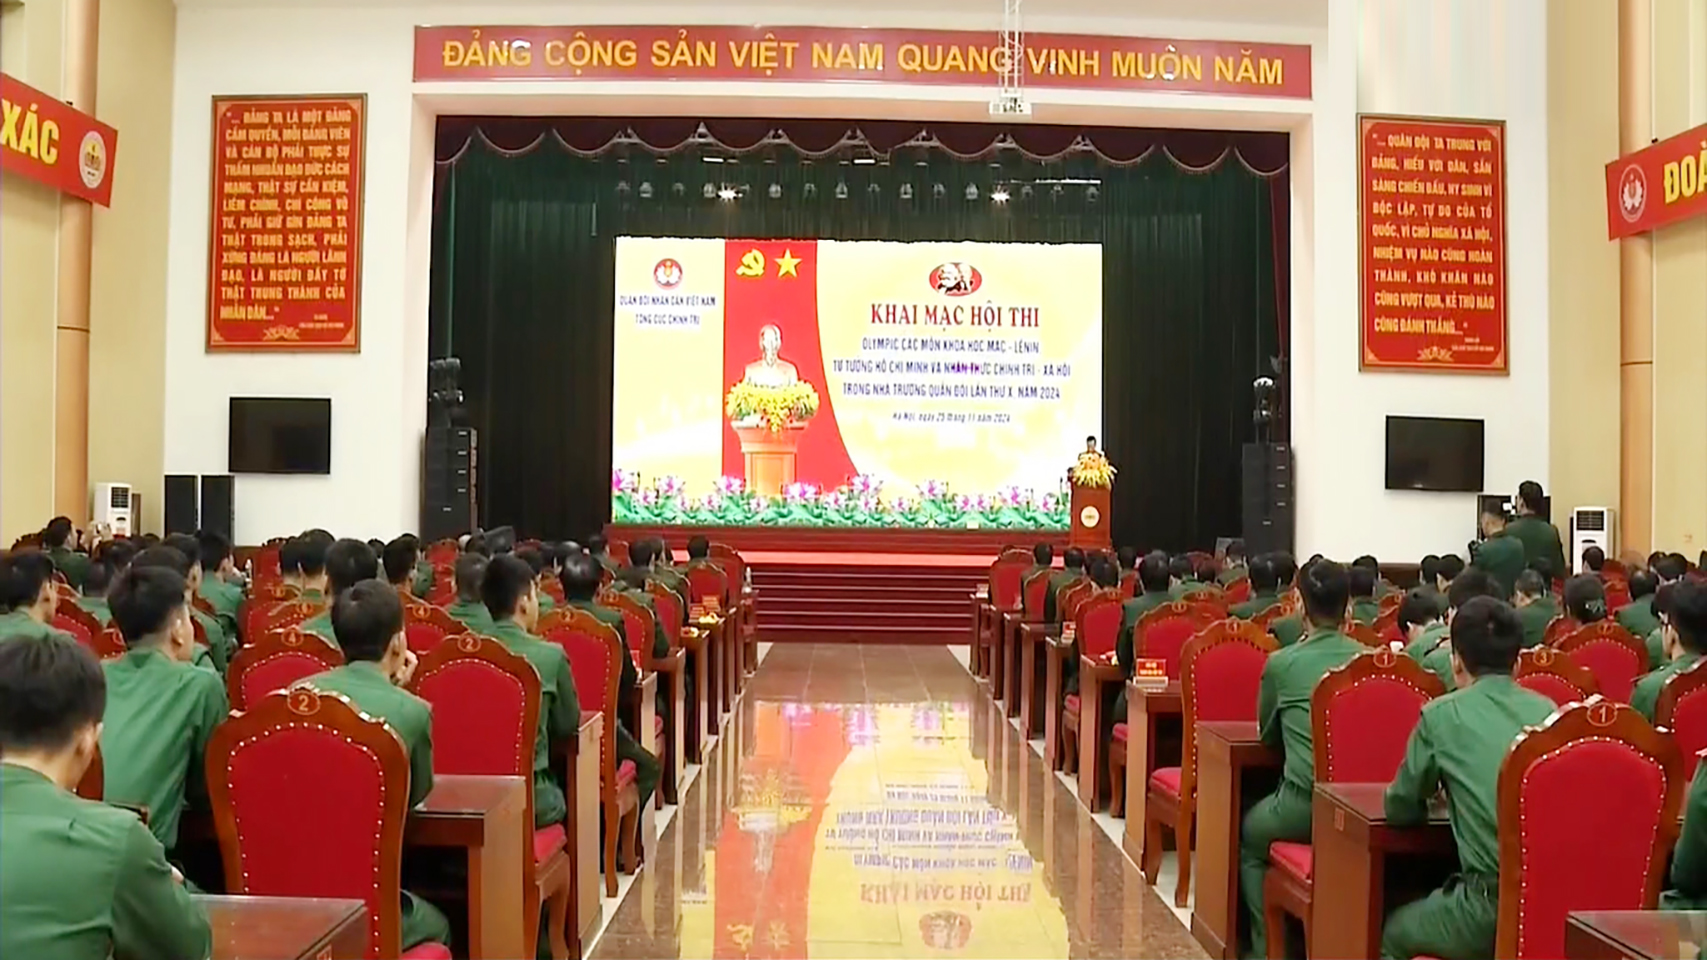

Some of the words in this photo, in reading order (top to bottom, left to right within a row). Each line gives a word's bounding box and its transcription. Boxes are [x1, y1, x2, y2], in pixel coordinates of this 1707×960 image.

[443, 30, 532, 67] ĐẢNG
[545, 32, 638, 75] CỘNG
[651, 29, 717, 67] SẢN
[728, 33, 799, 75] VIỆT
[812, 42, 883, 71] NAM
[898, 43, 1012, 74] QUANG
[1027, 47, 1100, 76] VINH
[1214, 49, 1283, 85] NĂM
[0, 98, 59, 165] XÁC
[871, 304, 917, 324] KHAI
[925, 304, 964, 332] MẠC
[970, 300, 1002, 332] HỘI
[1008, 307, 1039, 327] THI
[862, 336, 899, 350] OLYMPIC
[298, 695, 308, 712] 2
